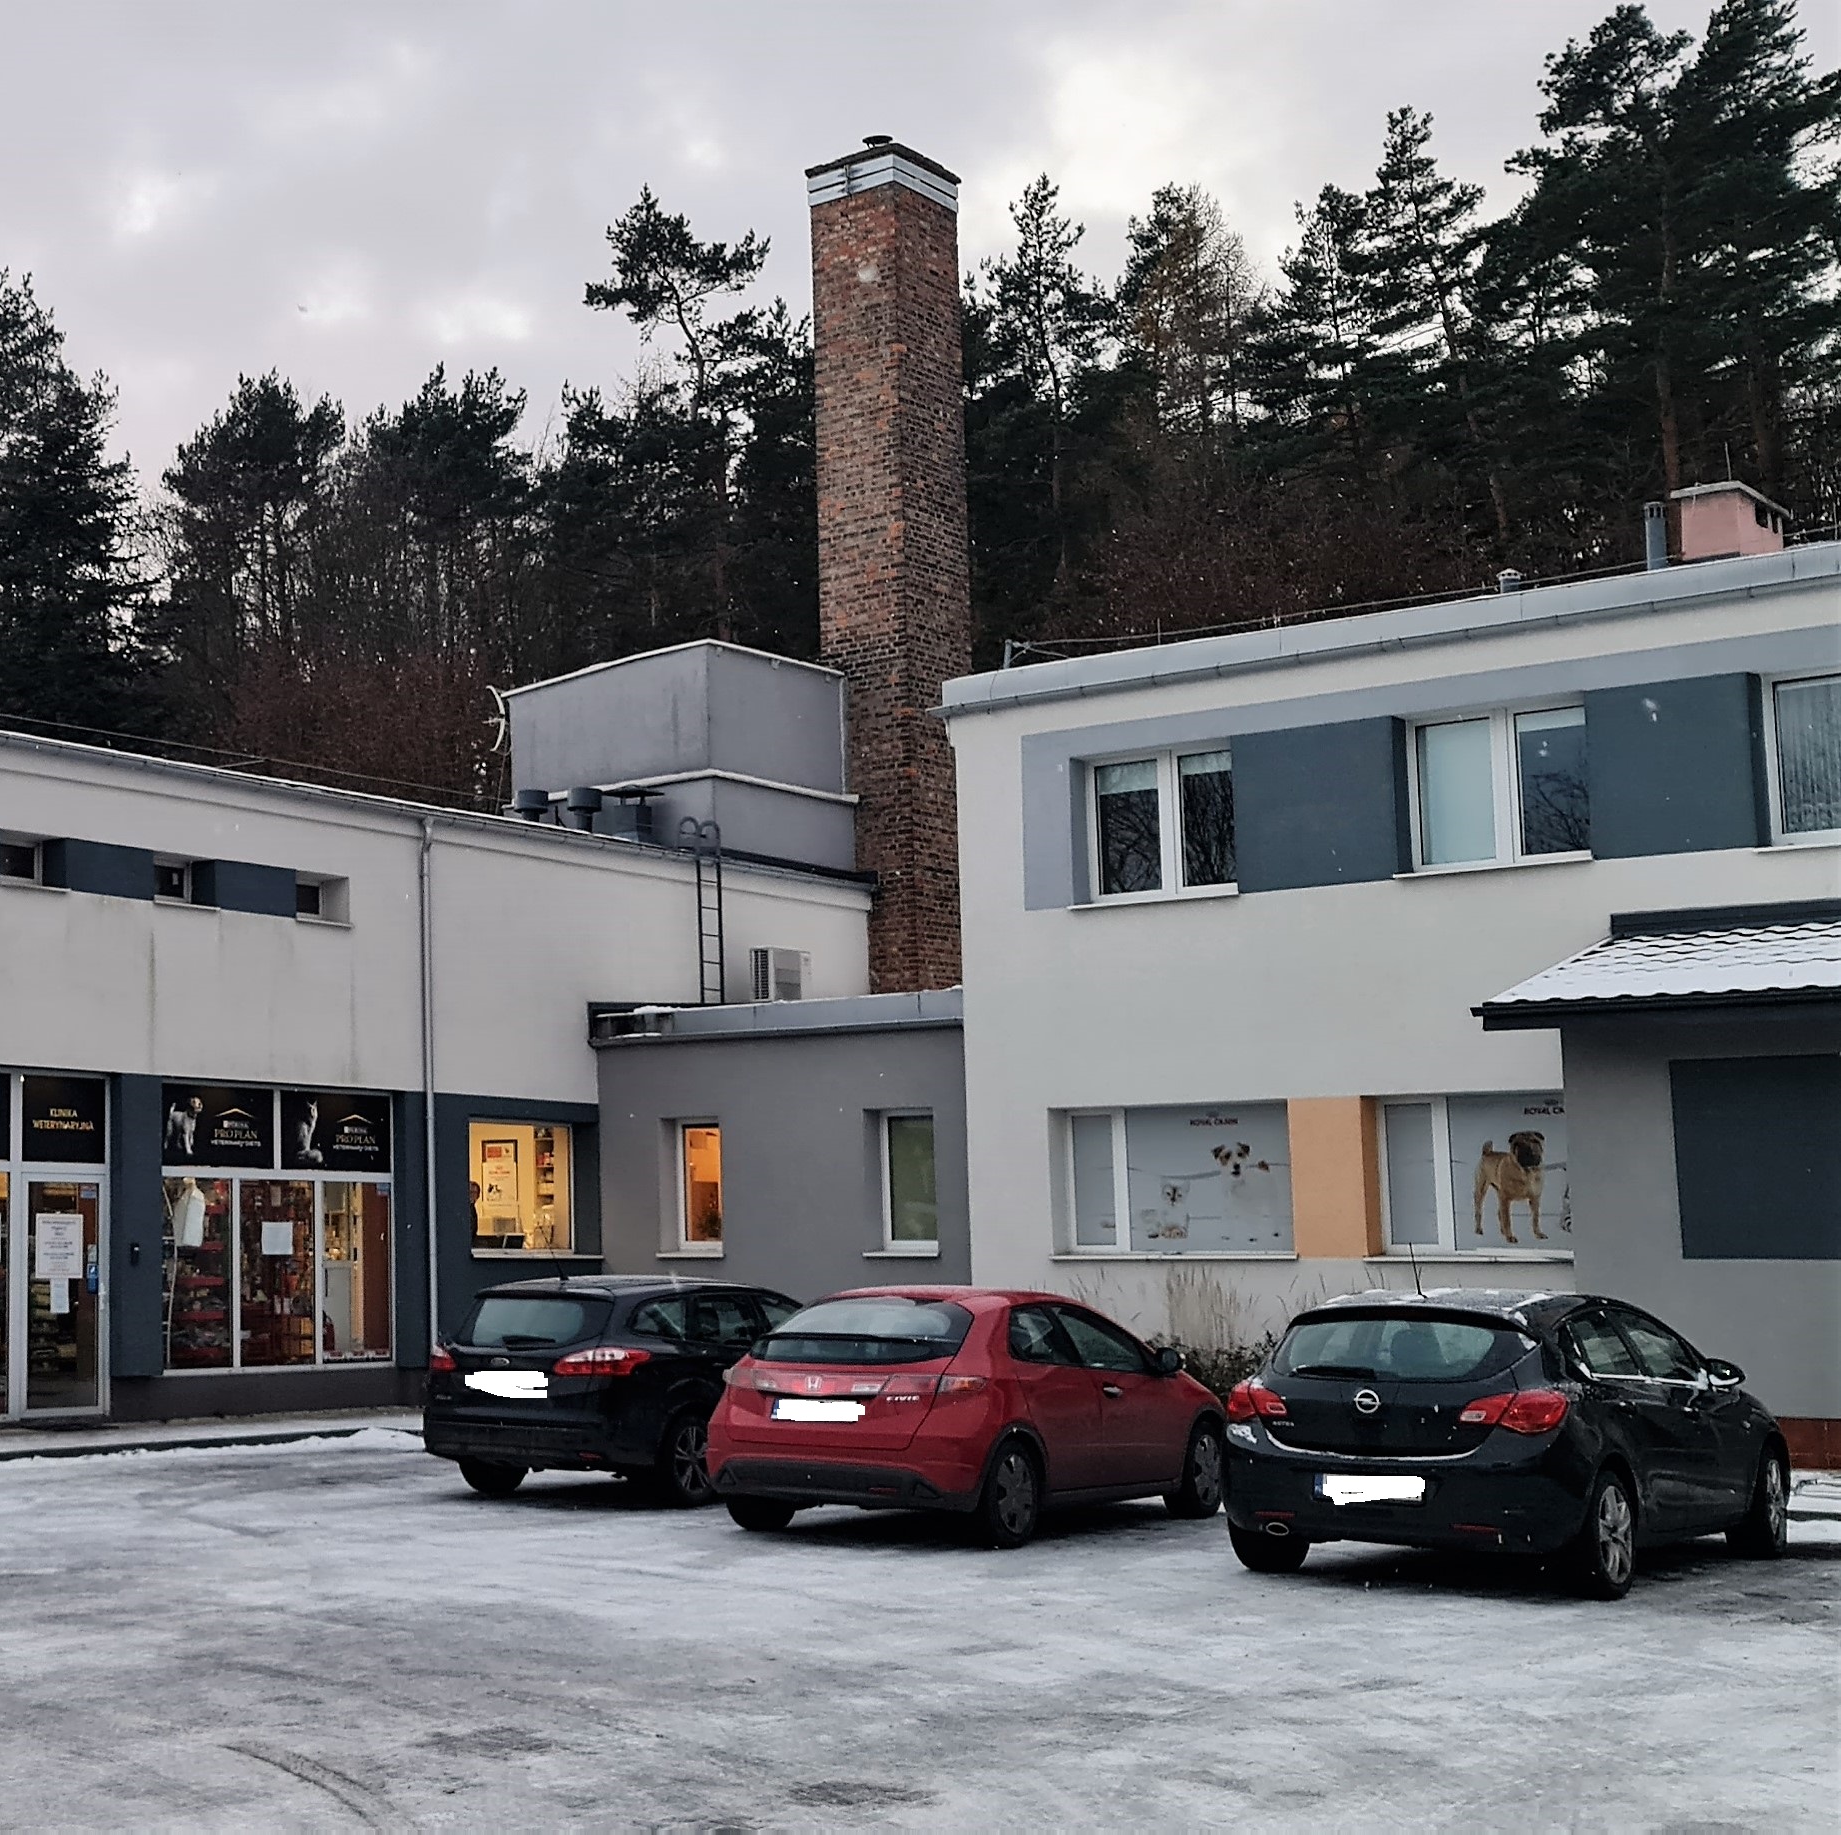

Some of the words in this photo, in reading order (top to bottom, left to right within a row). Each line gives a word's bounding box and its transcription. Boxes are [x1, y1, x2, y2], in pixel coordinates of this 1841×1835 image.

[49, 1108, 78, 1118] KLINIKA
[1524, 1107, 1551, 1115] ROYAL
[32, 1120, 95, 1131] WETERYNARYJNA
[214, 1128, 234, 1138] PRO
[234, 1130, 258, 1139] PLAN
[335, 1134, 354, 1143] PRO
[354, 1135, 376, 1144] PLAN
